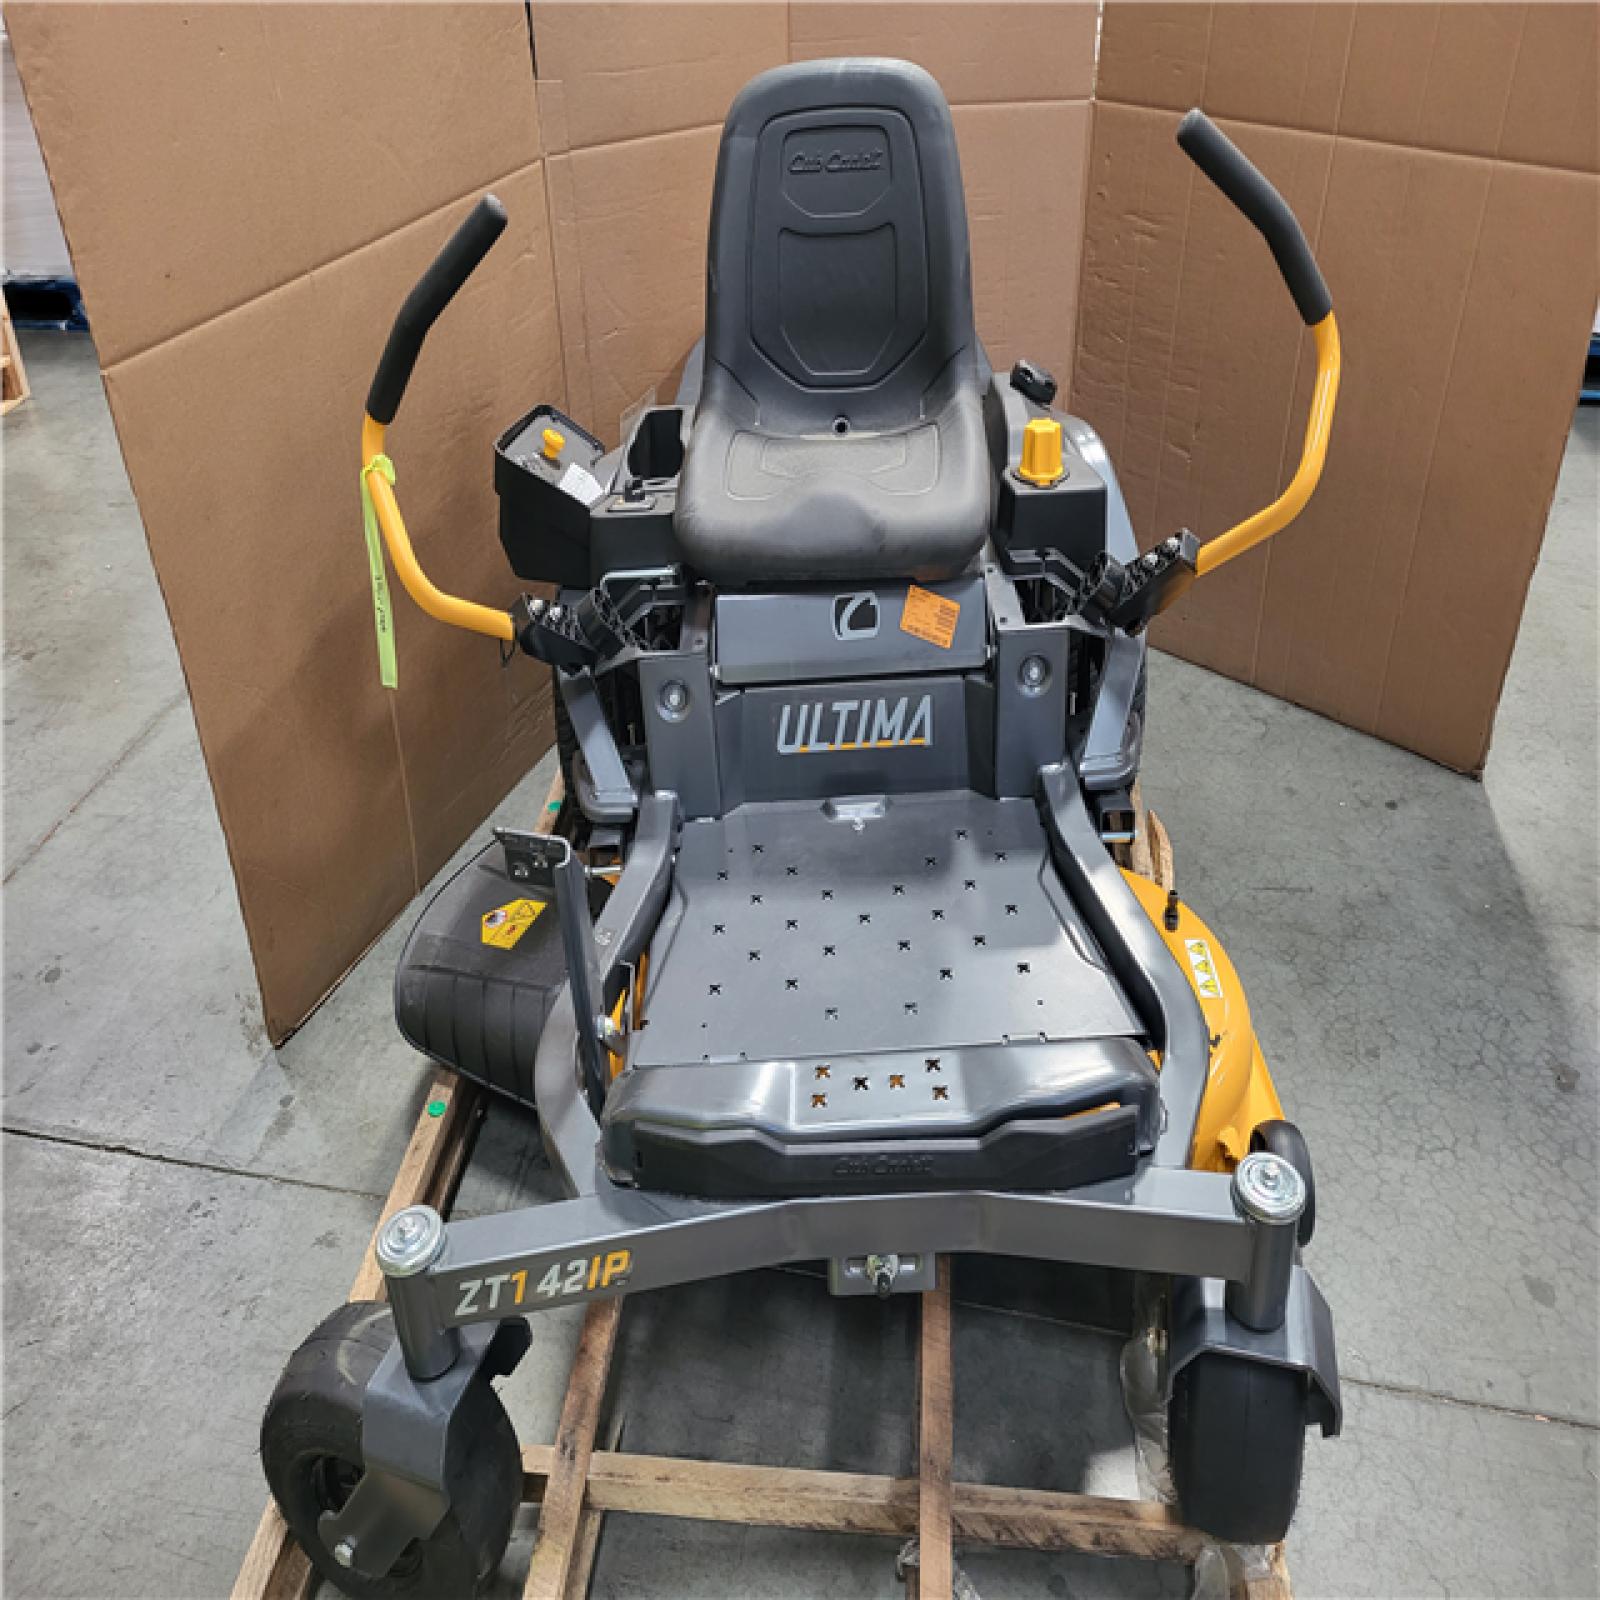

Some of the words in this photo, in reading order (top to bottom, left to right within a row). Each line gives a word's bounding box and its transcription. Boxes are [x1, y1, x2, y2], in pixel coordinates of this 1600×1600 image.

[777, 694, 933, 754] ULTIMA
[454, 1269, 529, 1316] ZT1
[536, 1249, 631, 1298] 42IP
